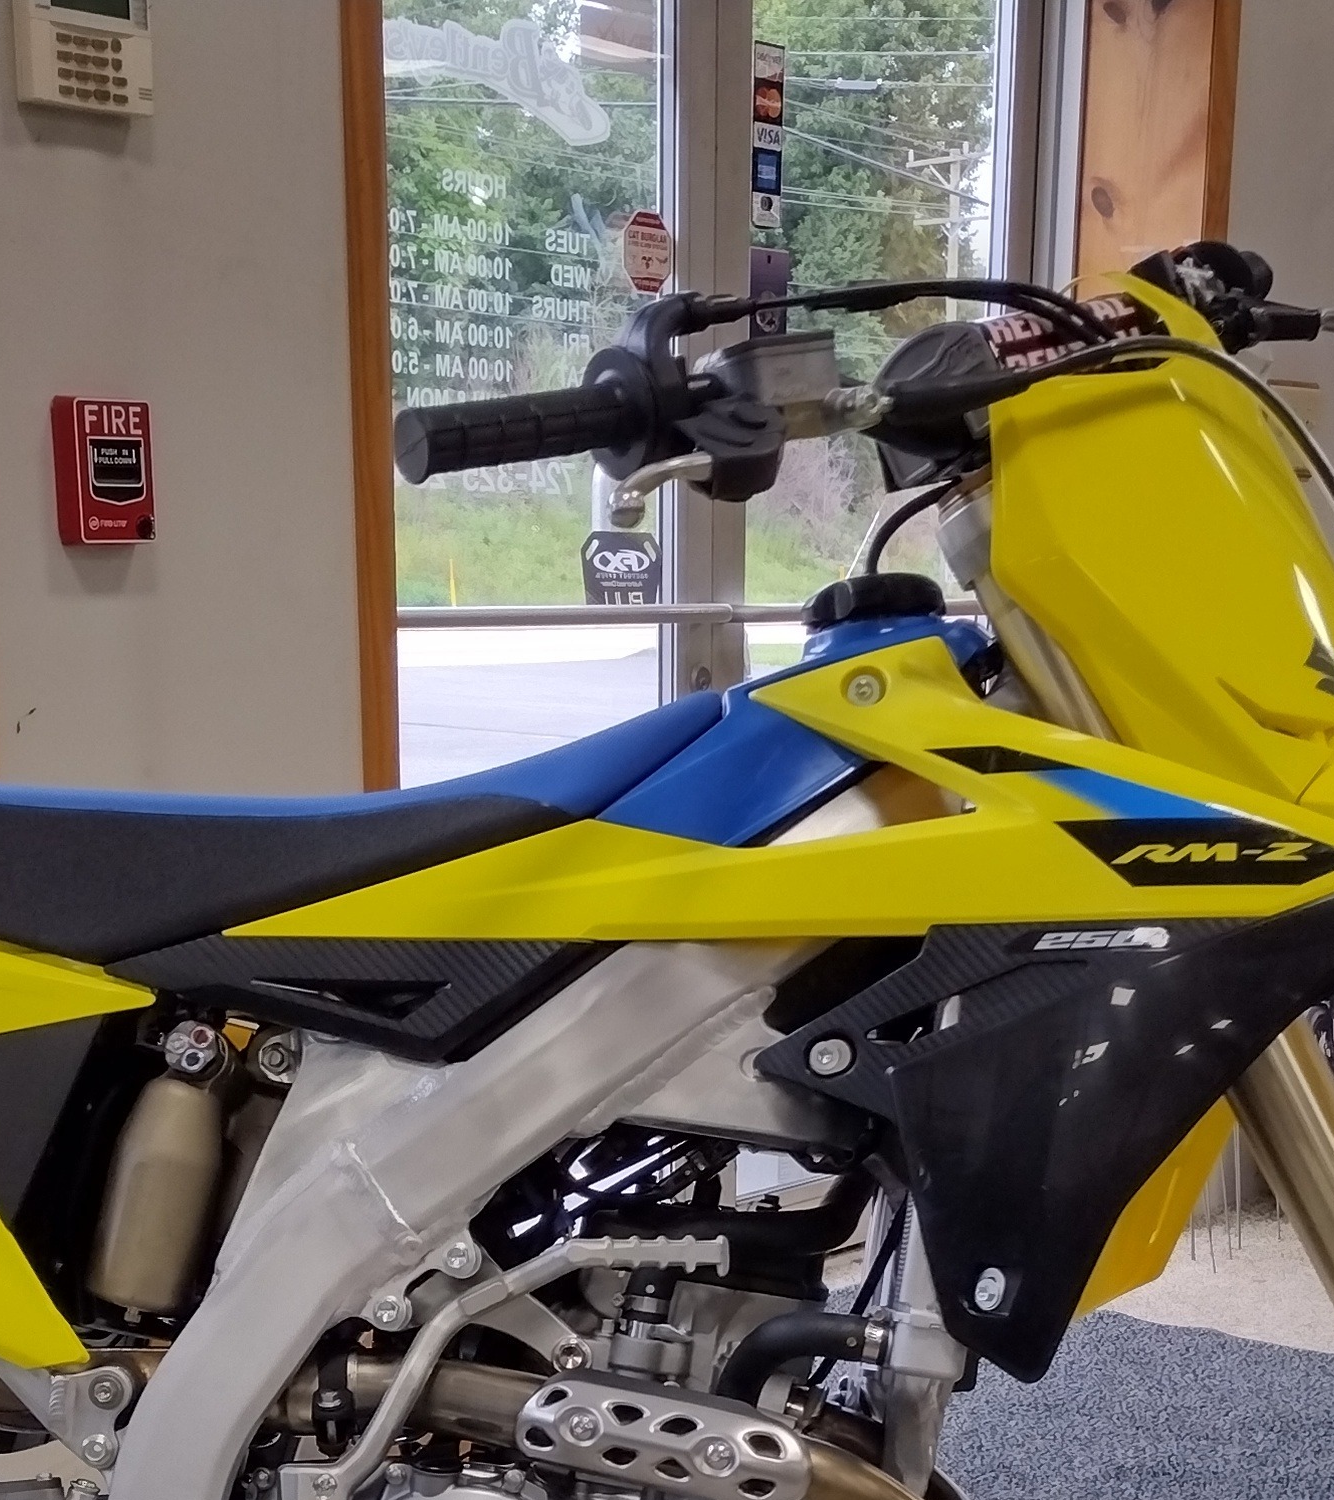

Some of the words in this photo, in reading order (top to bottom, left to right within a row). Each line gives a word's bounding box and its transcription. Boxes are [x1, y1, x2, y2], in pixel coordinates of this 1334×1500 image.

[756, 127, 781, 146] VISA
[83, 404, 143, 435] FIRE
[100, 448, 118, 456] PUSH
[1110, 841, 1314, 865] RM-Z
